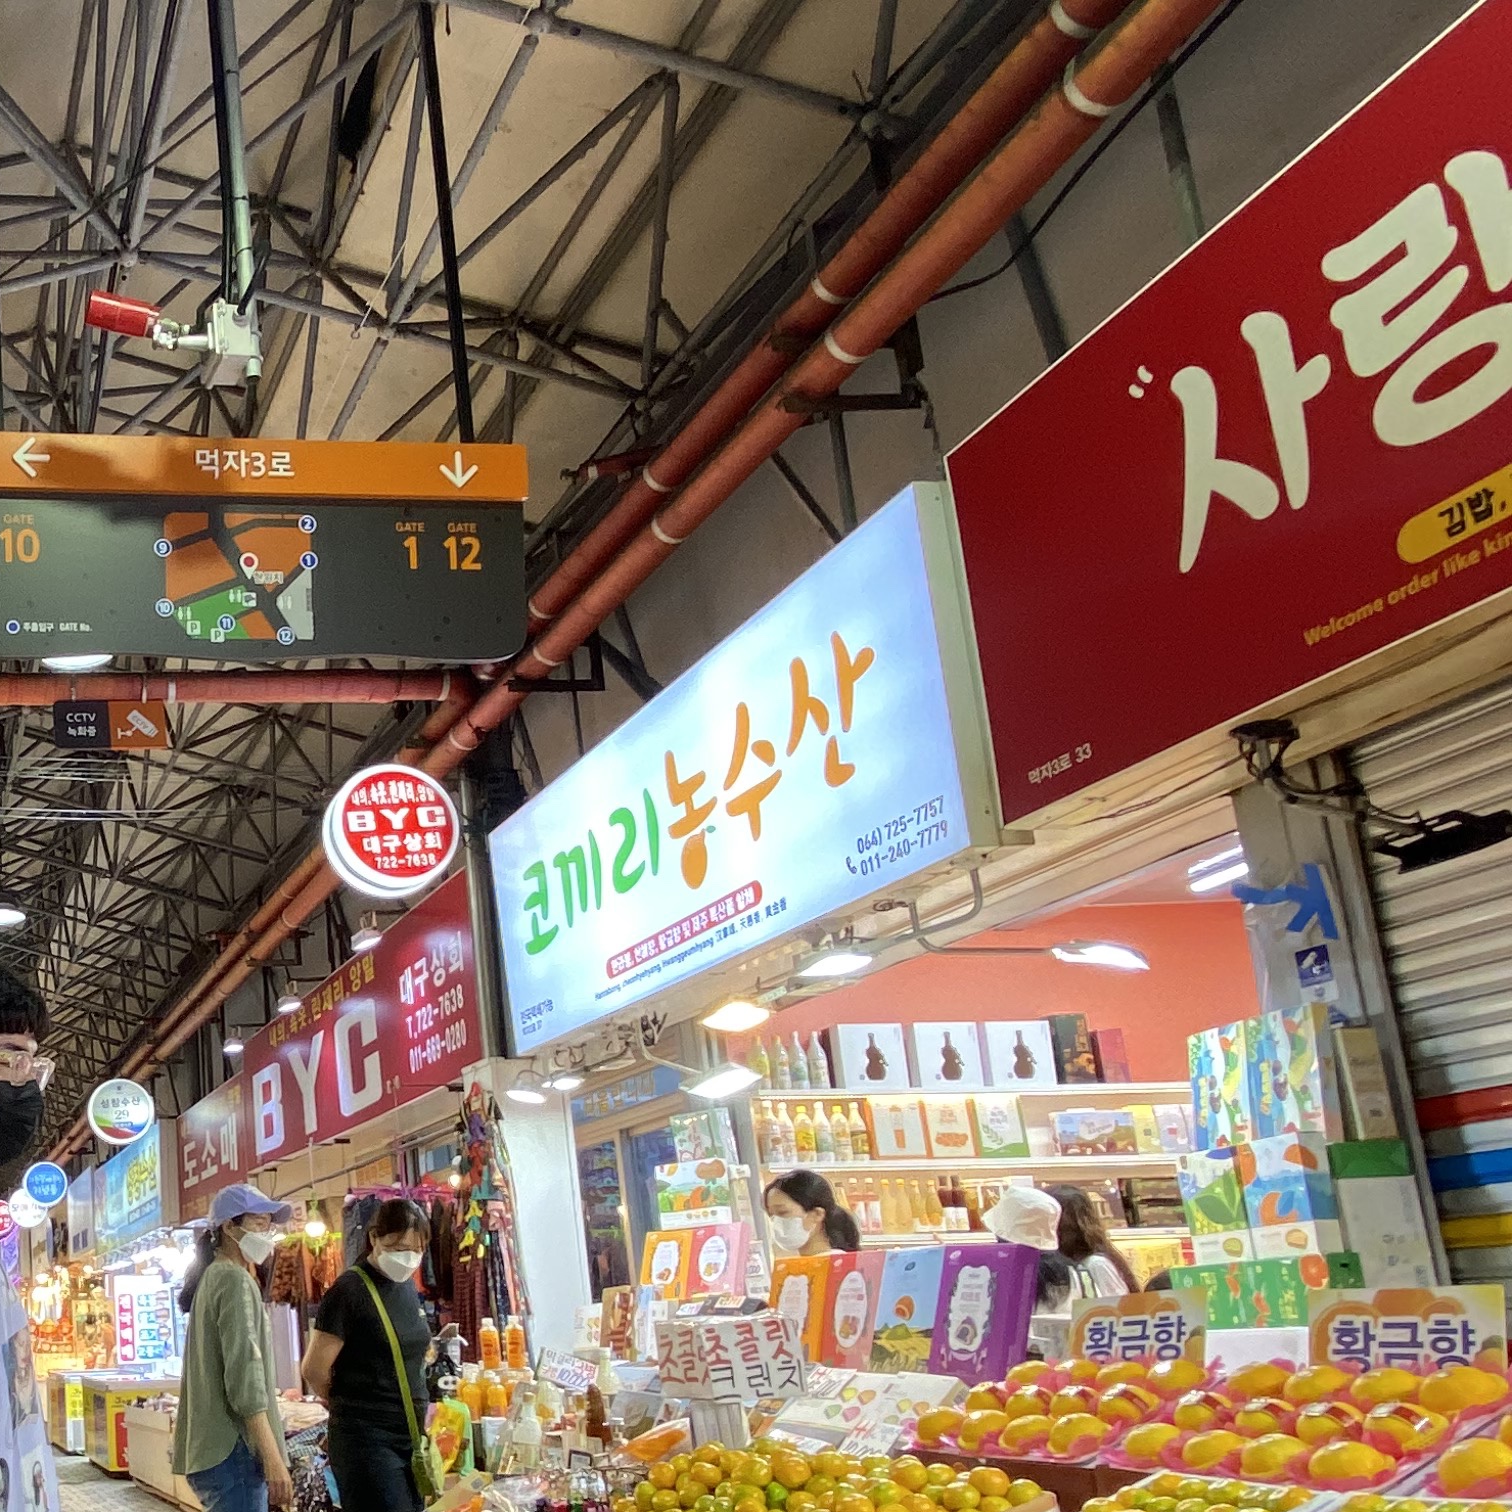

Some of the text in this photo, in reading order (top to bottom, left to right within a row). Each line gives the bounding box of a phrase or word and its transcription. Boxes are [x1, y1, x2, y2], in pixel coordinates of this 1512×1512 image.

[194, 449, 295, 478] 먹자3로
[3, 513, 34, 525] GATE
[395, 521, 478, 534] GATE GATE
[0, 529, 40, 563] 10
[158, 541, 169, 555] 9
[402, 537, 482, 571] 1 12
[157, 602, 172, 614] 10
[1304, 598, 1384, 646] Welcome
[1387, 569, 1439, 605] order
[1442, 549, 1481, 578] like
[59, 622, 78, 631] GATE
[220, 617, 233, 629] 11
[278, 629, 294, 642] 12
[66, 713, 96, 722] CCTV
[1028, 743, 1092, 784] 먹자3로 33
[346, 806, 447, 832] BYC
[884, 795, 944, 840] 725-7757
[362, 832, 442, 854] 대구상회
[860, 820, 948, 876] 011-240-7779
[374, 853, 437, 869] 722-7638
[399, 930, 465, 1005] 대구상회
[405, 983, 464, 1039] T.722-7638
[251, 998, 384, 1157] BYC
[115, 1110, 130, 1120] 29
[182, 1112, 239, 1190] 도소매
[704, 1319, 795, 1367] 초콜릿
[1085, 1314, 1188, 1362] 황금향
[1331, 1318, 1478, 1370] 황금향
[711, 1358, 808, 1404] 크런치
